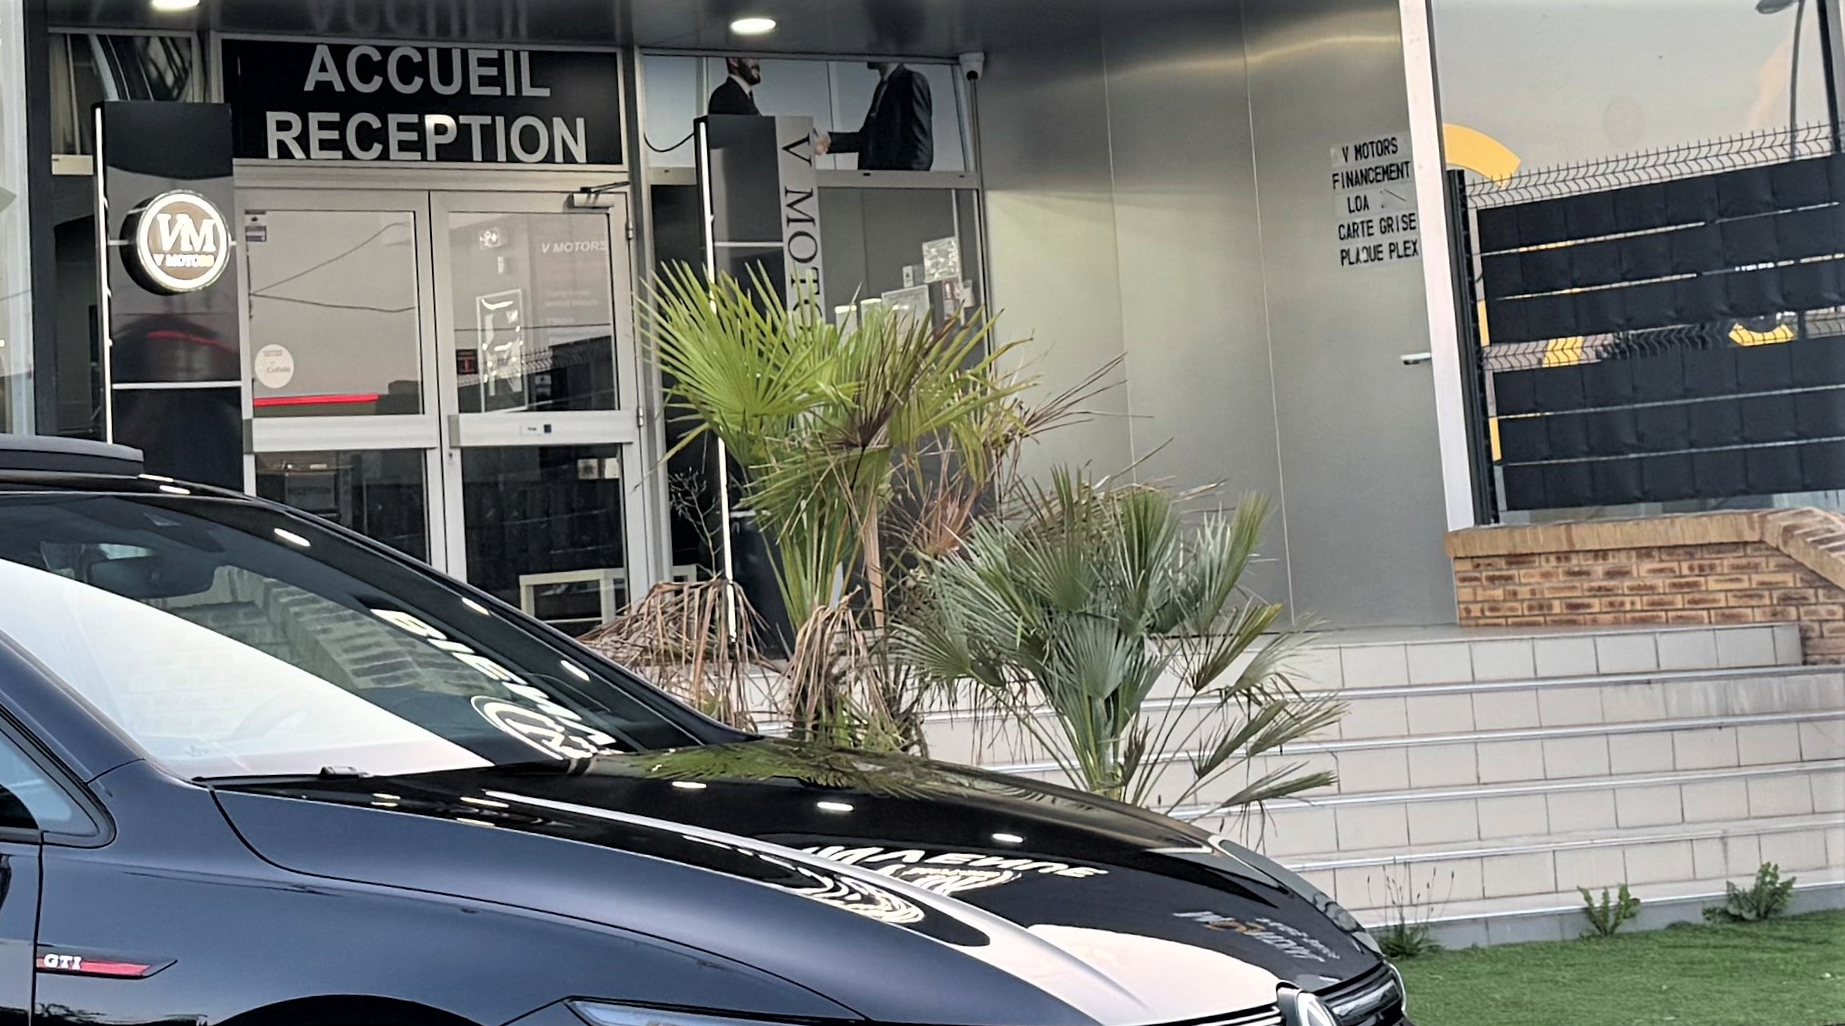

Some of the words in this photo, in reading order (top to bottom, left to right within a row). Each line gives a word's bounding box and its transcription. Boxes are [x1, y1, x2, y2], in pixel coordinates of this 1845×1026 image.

[304, 44, 551, 97] ACCUEIL
[265, 111, 587, 164] RECEPTION
[781, 133, 812, 167] V
[1342, 146, 1349, 162] V
[1354, 137, 1399, 161] MOTORS
[1332, 161, 1411, 190] FINANCEMENT
[1347, 195, 1370, 214] LOA
[156, 213, 216, 252] VM
[1338, 220, 1374, 241] CARTE
[1379, 212, 1417, 235] GRISE
[1388, 239, 1419, 260] PLEX
[44, 953, 82, 970] GTI
